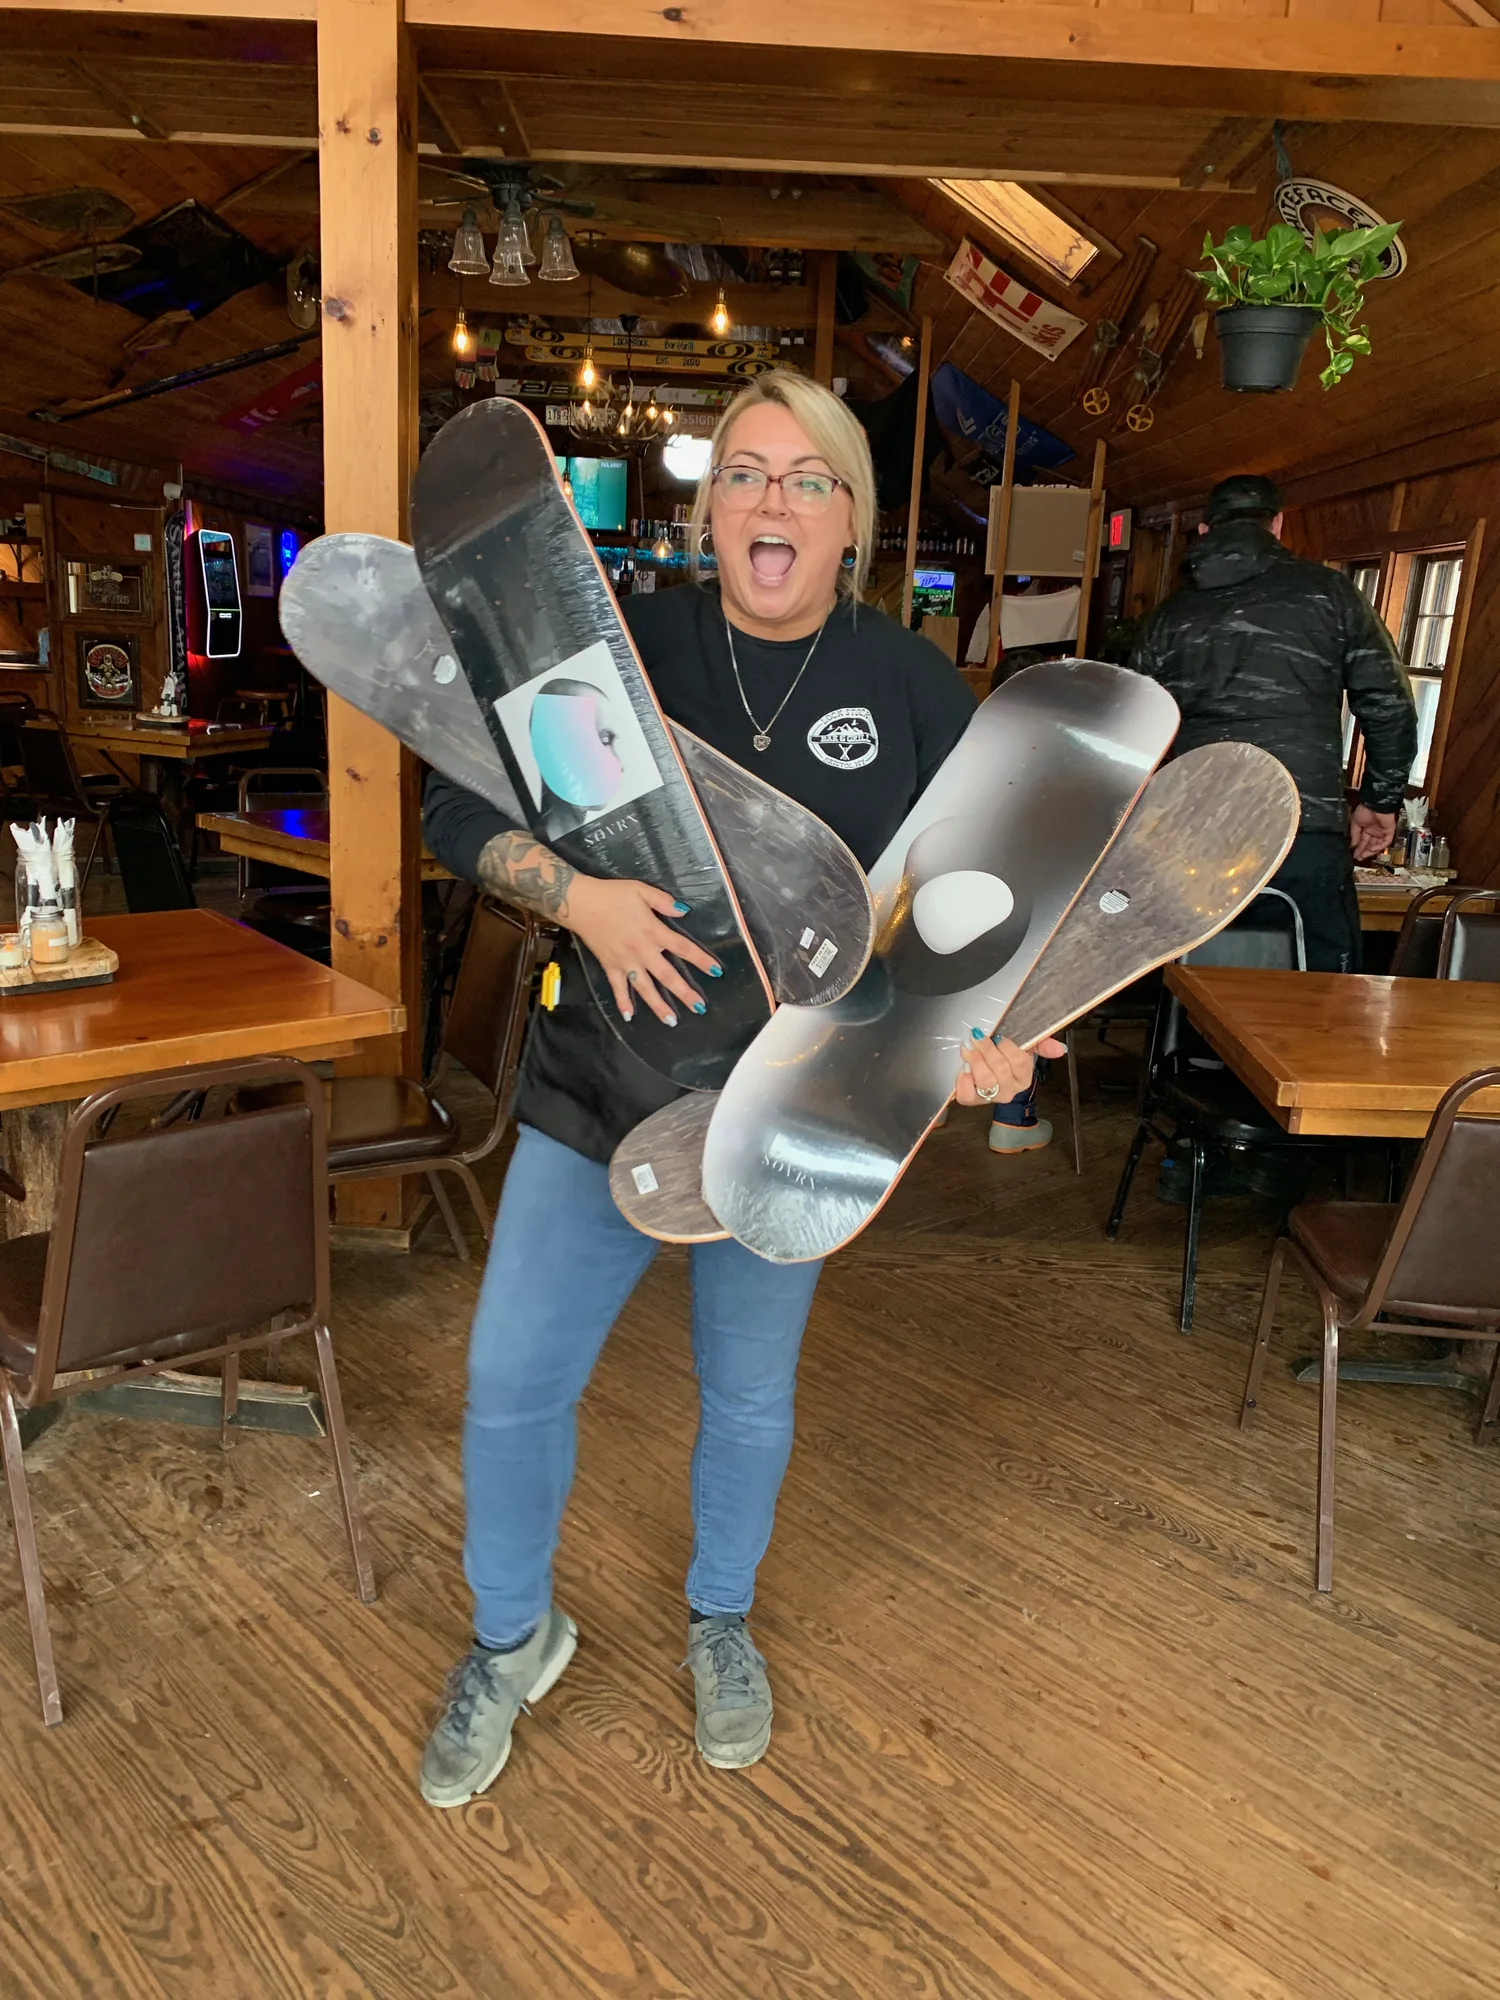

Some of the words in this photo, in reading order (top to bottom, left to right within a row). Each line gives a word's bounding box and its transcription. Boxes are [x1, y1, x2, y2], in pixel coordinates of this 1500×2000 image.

[169, 524, 183, 619] SAMUEL
[820, 709, 844, 724] LOCK
[845, 709, 871, 719] STOCK
[821, 734, 839, 742] BAR
[847, 733, 871, 742] GRILL
